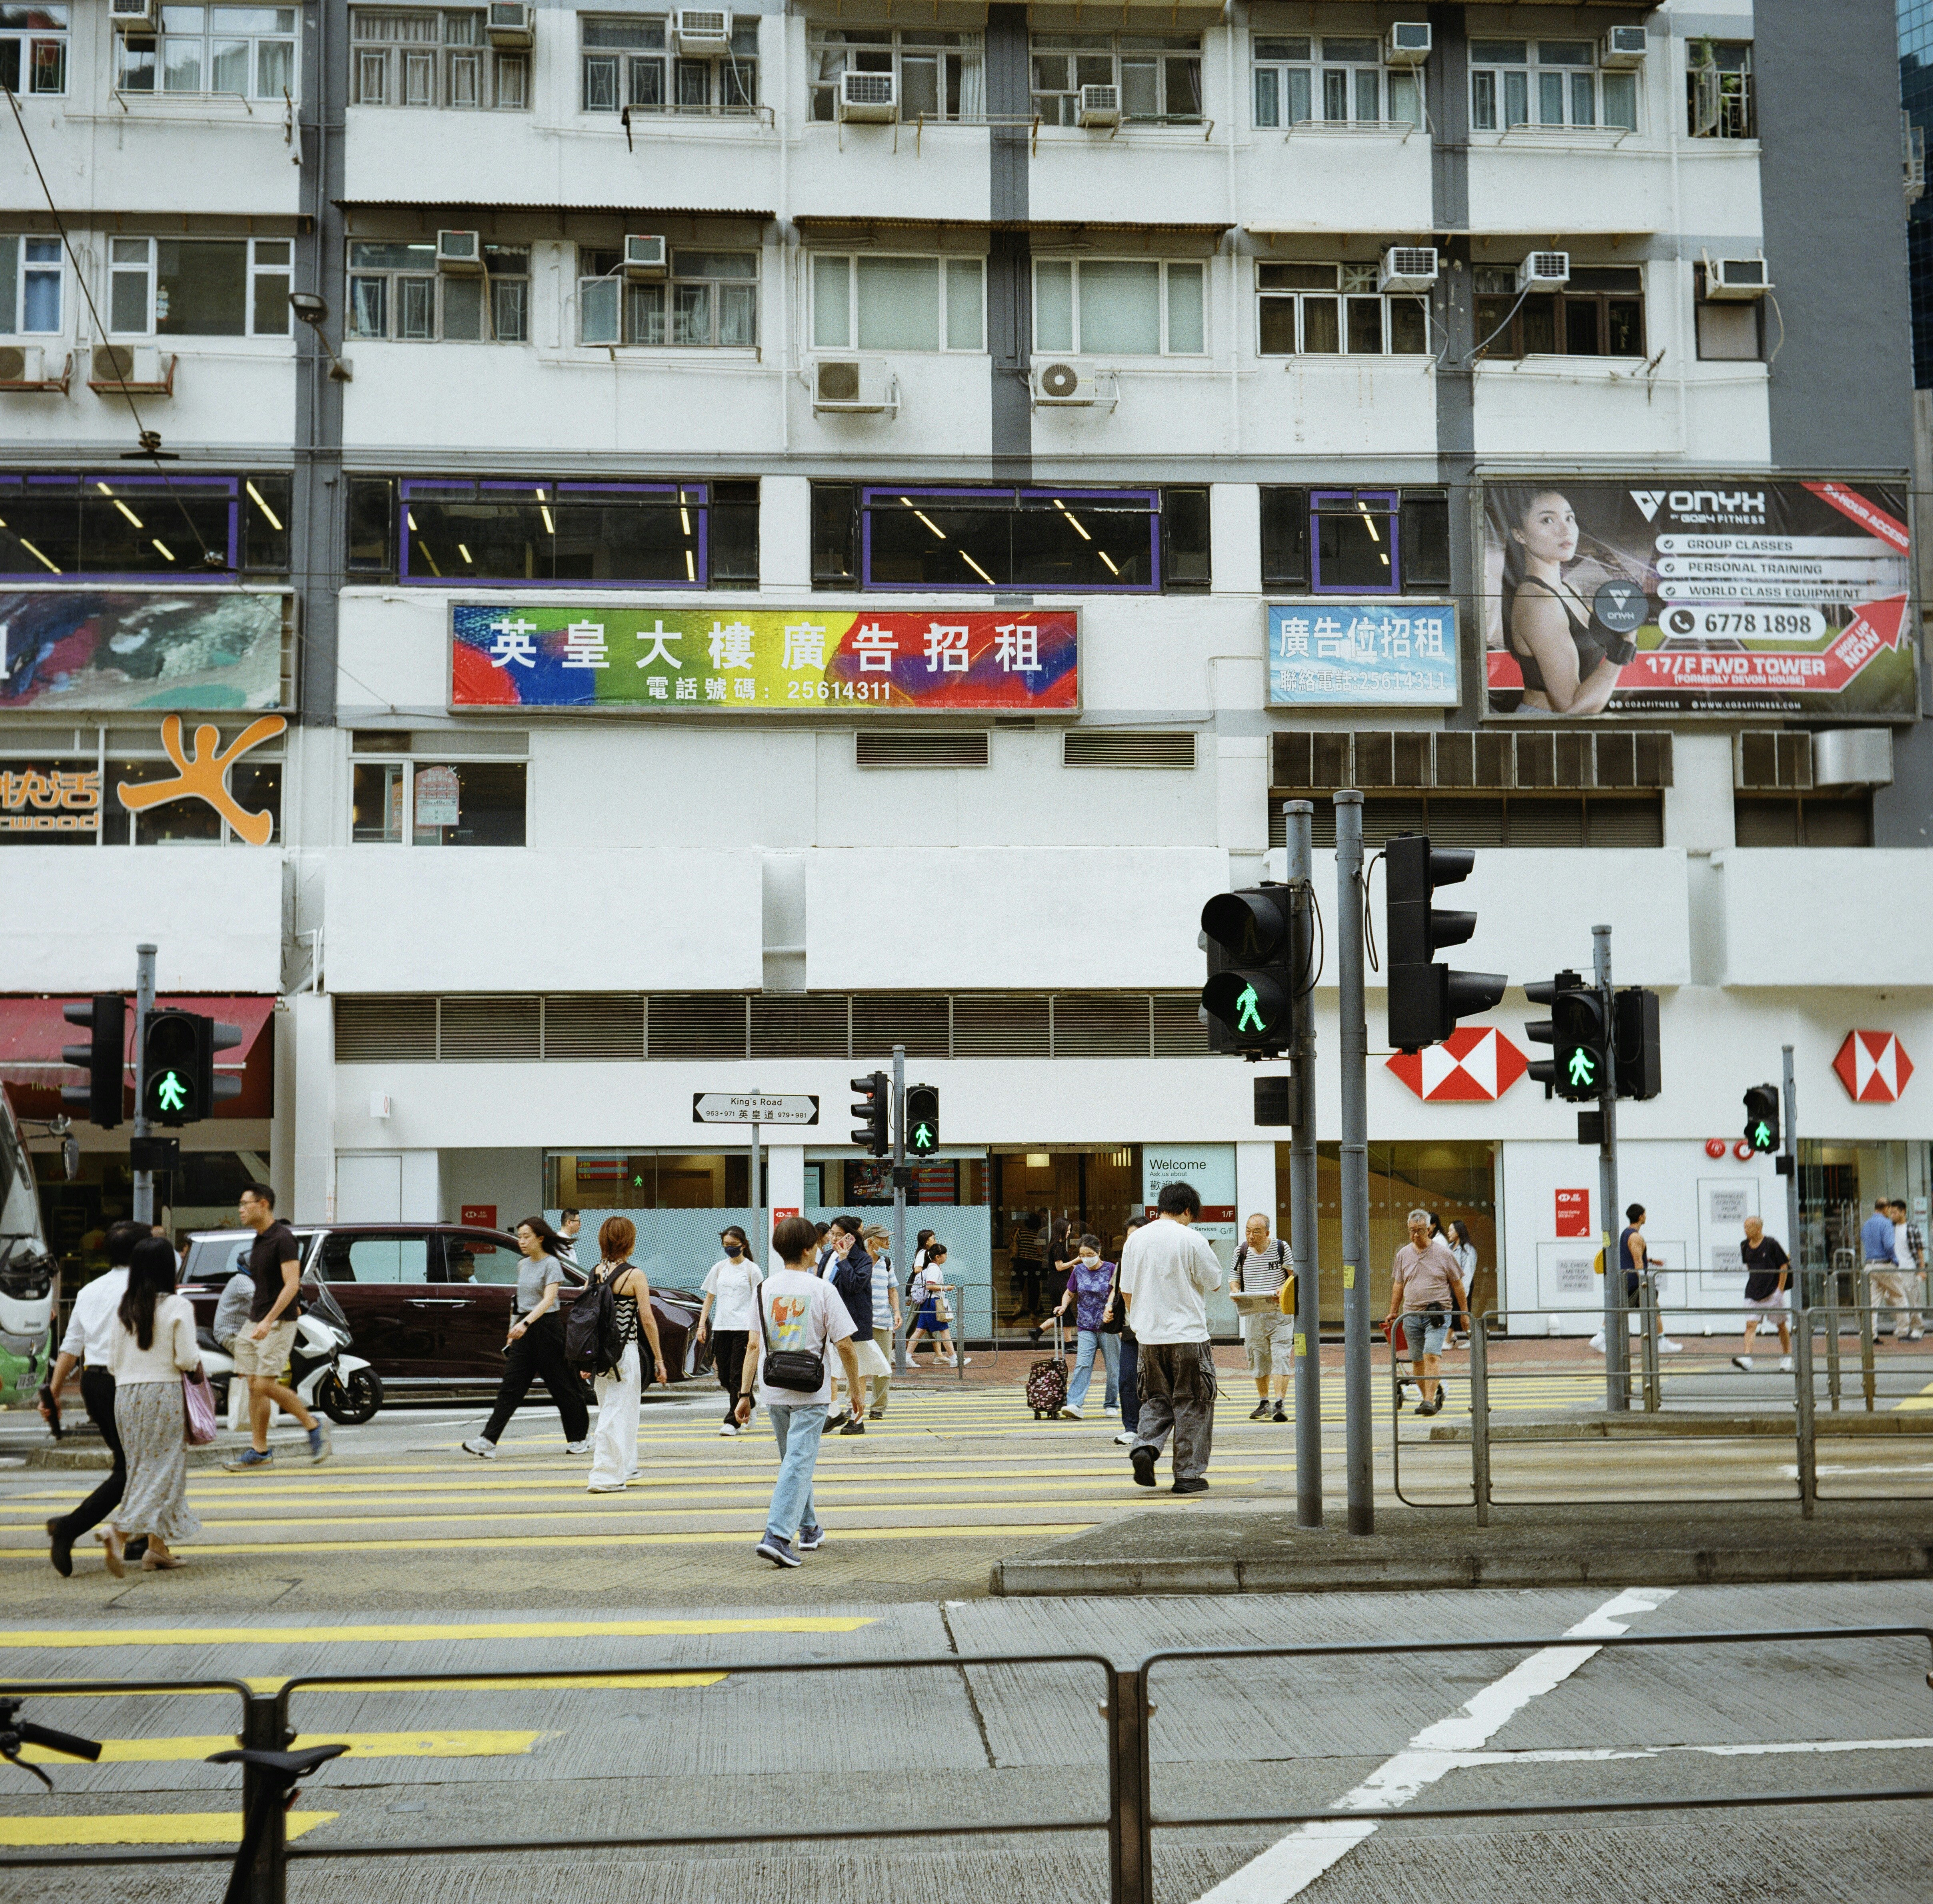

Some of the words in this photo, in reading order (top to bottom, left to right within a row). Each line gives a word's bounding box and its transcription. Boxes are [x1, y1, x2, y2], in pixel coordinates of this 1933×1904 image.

[1669, 491, 1765, 512] ONYX
[1717, 514, 1766, 524] FITNESS
[1867, 515, 1909, 547] ACCESS
[1687, 540, 1732, 549] GROUP
[1736, 540, 1793, 550] CLASSES
[1688, 562, 1757, 572] PERSONAL
[1761, 564, 1823, 574] TRAINING
[1689, 586, 1737, 596] WORLD
[1740, 587, 1781, 596] CLASS
[1785, 588, 1861, 598] EQUIPMENT
[1705, 614, 1756, 632] 6778
[1763, 614, 1811, 633] 1898
[1855, 620, 1869, 637] UP
[1279, 616, 1446, 658] 廣告位招租
[490, 619, 1043, 673] 英皇大樓廣告招租
[1843, 627, 1880, 670] NOW
[1646, 658, 1696, 675] 17/F
[1701, 658, 1749, 675] FWD
[1755, 659, 1826, 676] TOWER
[1675, 674, 1730, 685] (FORMERLY
[1731, 675, 1766, 684] DEVON
[1769, 676, 1805, 686] HOUSE)
[787, 680, 890, 700] 25614311
[731, 1098, 756, 1106] King's
[760, 1098, 782, 1106] Road
[738, 1109, 774, 1120] 英皇道
[1149, 1159, 1207, 1170] Welcome
